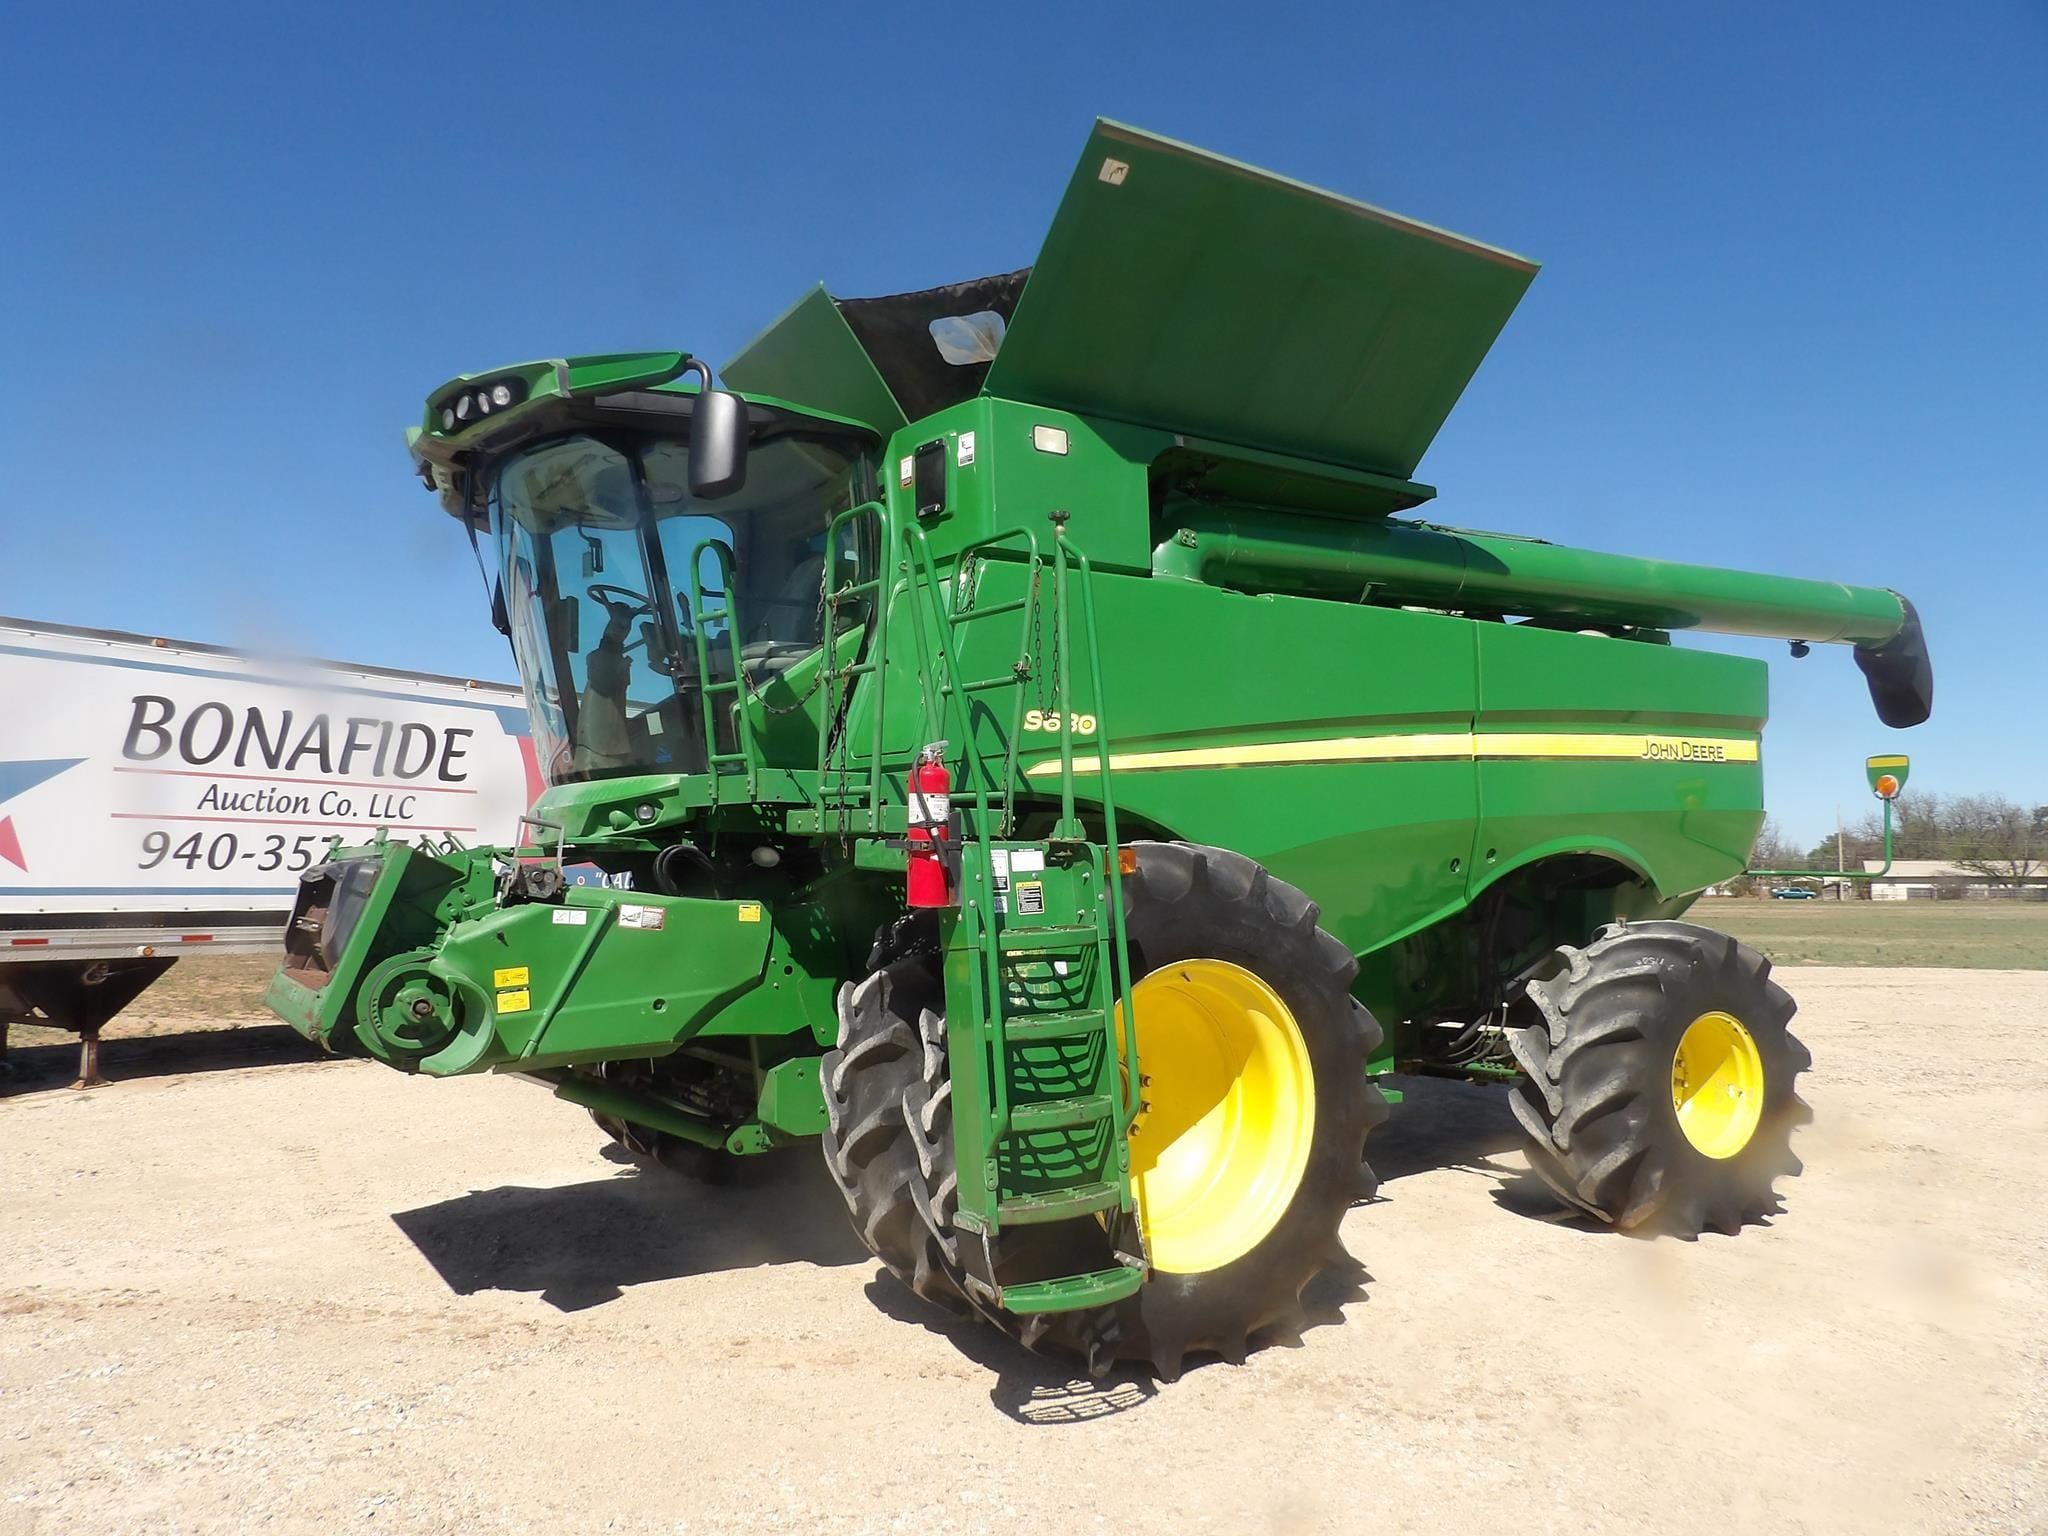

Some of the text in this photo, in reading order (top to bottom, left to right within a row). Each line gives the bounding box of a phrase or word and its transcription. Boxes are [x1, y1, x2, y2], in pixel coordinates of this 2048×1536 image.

[122, 694, 474, 782] BONAFIDE
[1642, 739, 1725, 761] JOHN DEERE
[197, 783, 417, 820] Auction Co. LLC
